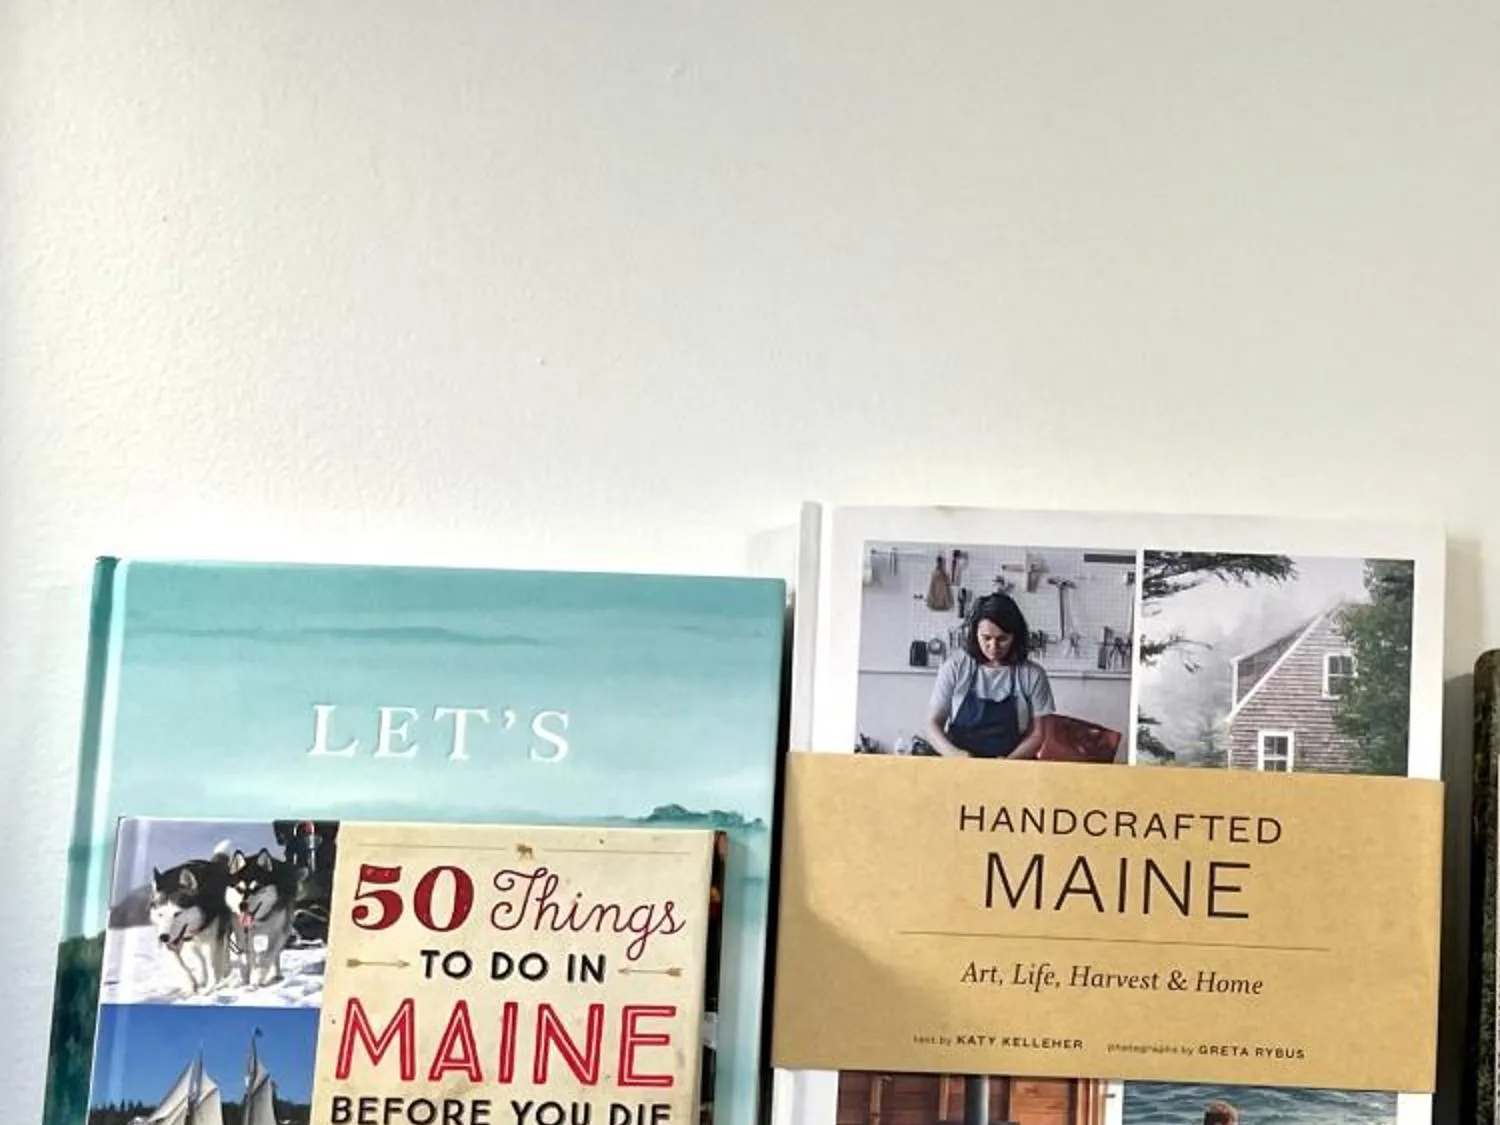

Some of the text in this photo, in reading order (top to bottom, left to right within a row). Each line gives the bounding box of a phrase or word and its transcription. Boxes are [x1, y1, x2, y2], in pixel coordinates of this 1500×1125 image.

[306, 703, 570, 763] LET'S
[959, 804, 1282, 844] HANDCRAFTED
[985, 852, 1251, 919] MAINE
[352, 863, 686, 962] 50 Things
[421, 950, 606, 983] TO DO IN
[960, 961, 1264, 995] Art, Life, Harvest & Home
[335, 997, 677, 1087] MAINE
[956, 1035, 996, 1046] KATY
[1001, 1036, 1083, 1049] KELLEHER
[1199, 1045, 1249, 1057] GRETA
[1255, 1047, 1305, 1059] RYBUS
